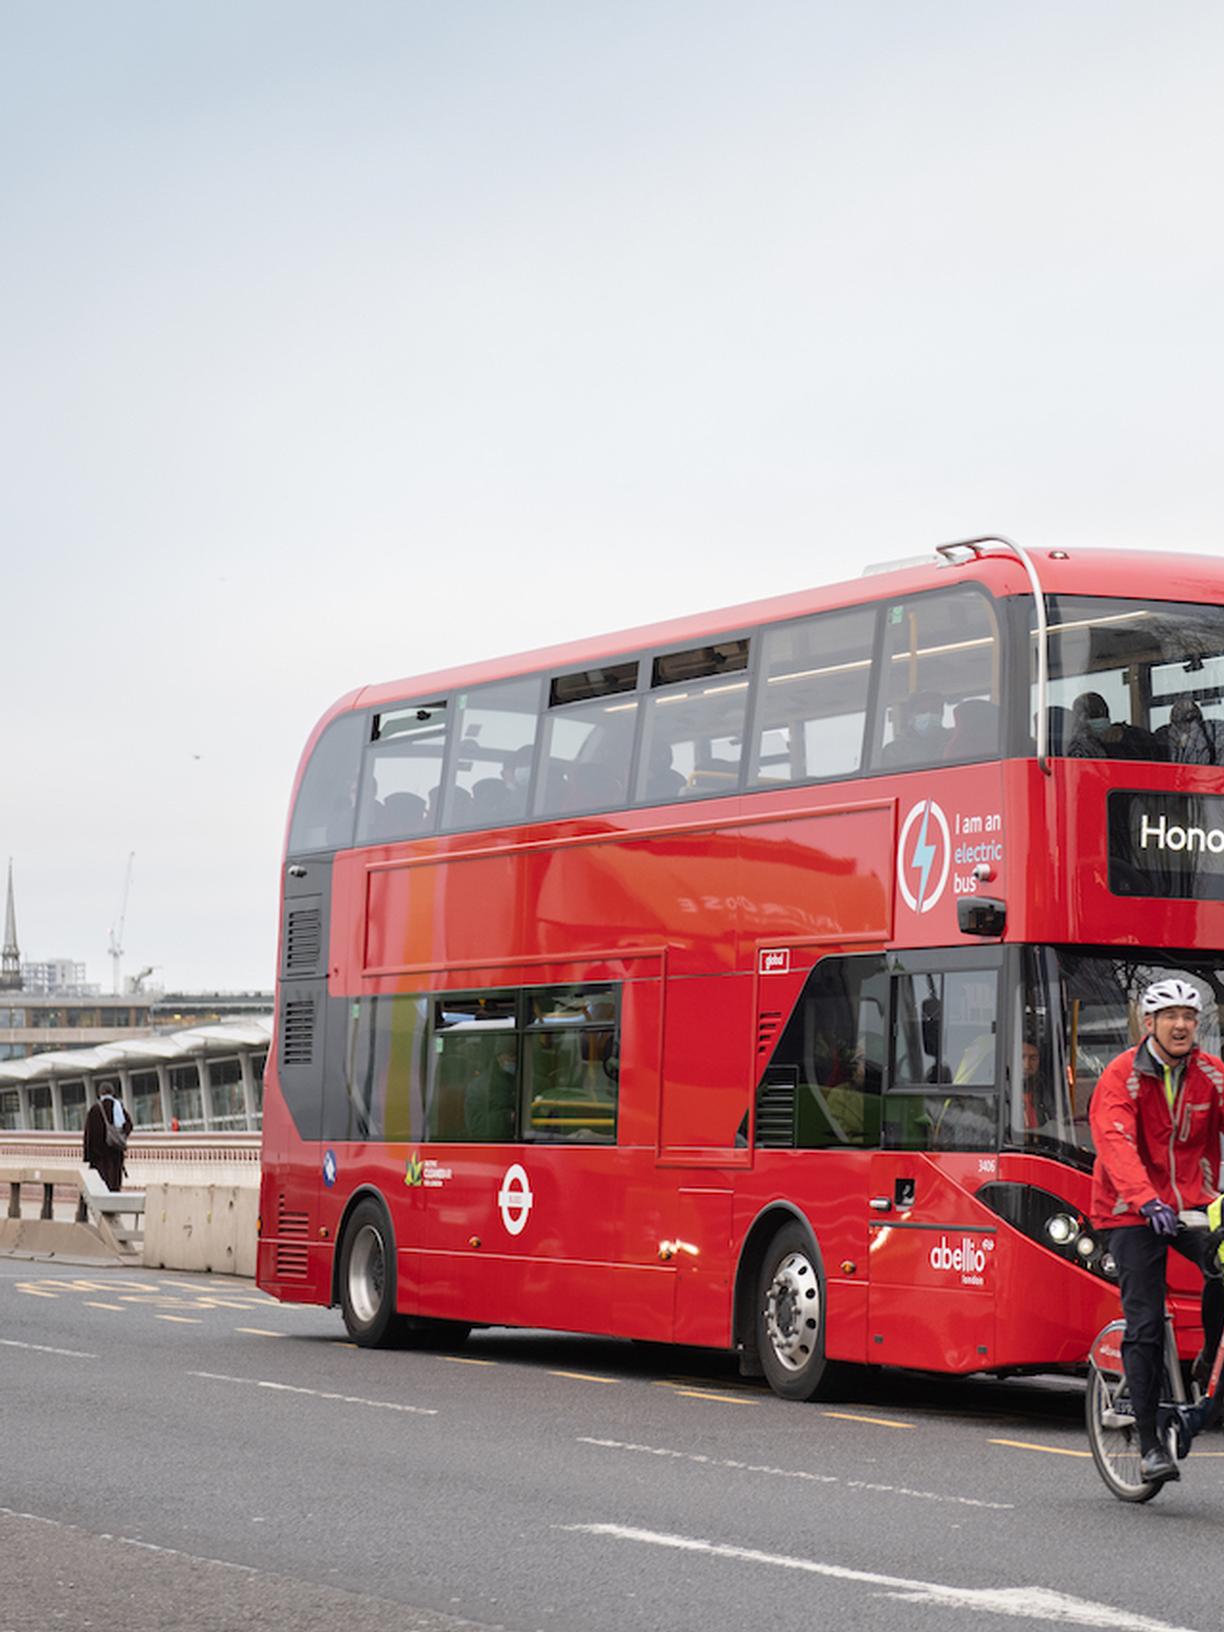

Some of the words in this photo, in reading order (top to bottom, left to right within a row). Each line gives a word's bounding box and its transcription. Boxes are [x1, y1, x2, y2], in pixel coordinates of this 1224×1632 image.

[962, 815, 983, 834] am
[985, 813, 1001, 832] an
[955, 839, 1002, 864] electric
[953, 872, 977, 894] bus
[930, 1236, 985, 1272] abellio
